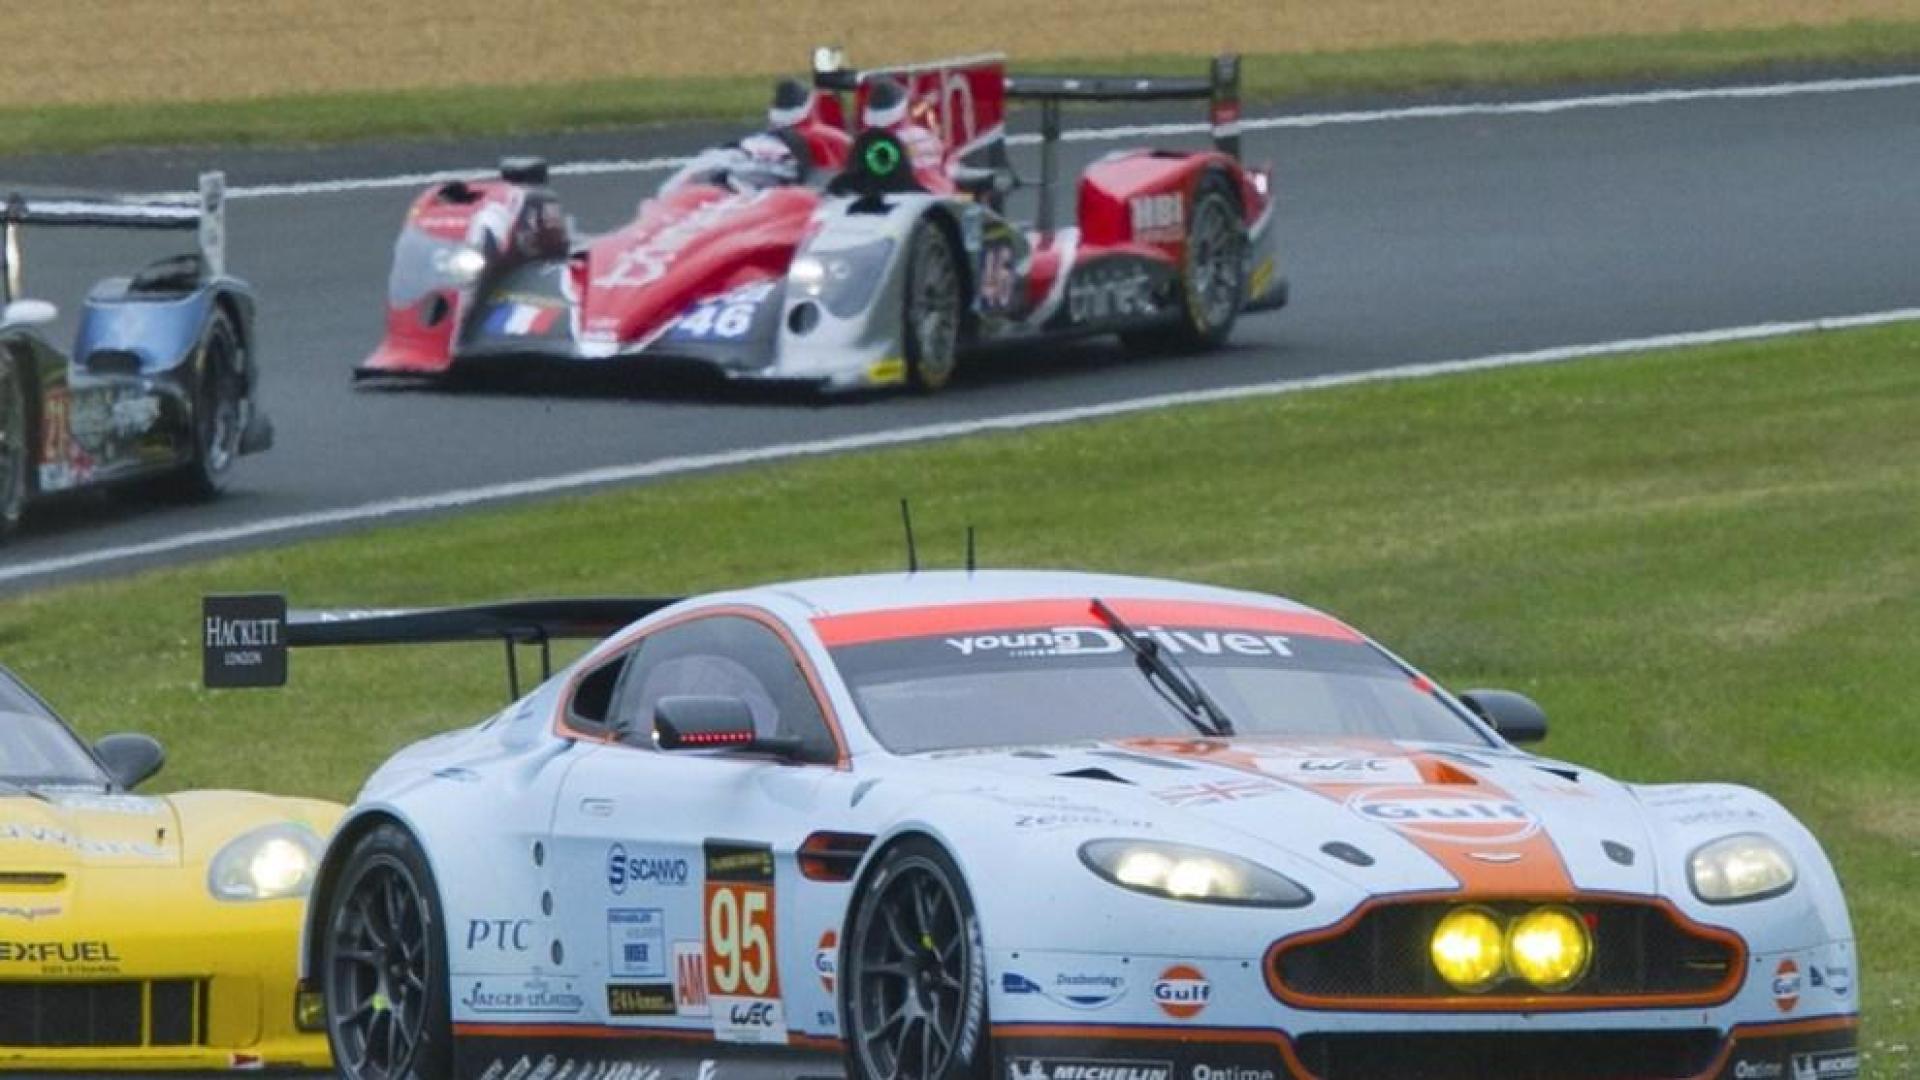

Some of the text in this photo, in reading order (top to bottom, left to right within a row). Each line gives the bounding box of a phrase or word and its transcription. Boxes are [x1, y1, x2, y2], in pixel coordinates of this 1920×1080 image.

[679, 303, 756, 338] 46
[206, 616, 279, 647] HACKETT
[224, 652, 262, 665] LONDON
[1361, 803, 1526, 818] Gulf
[629, 857, 688, 882] SCANVO
[467, 918, 535, 952] PTC
[710, 887, 771, 994] 95
[1155, 982, 1209, 1001] Gulf
[731, 1003, 774, 1026] WEC
[1053, 1064, 1168, 1080] MICHELIN
[1193, 1064, 1273, 1080] Ontime
